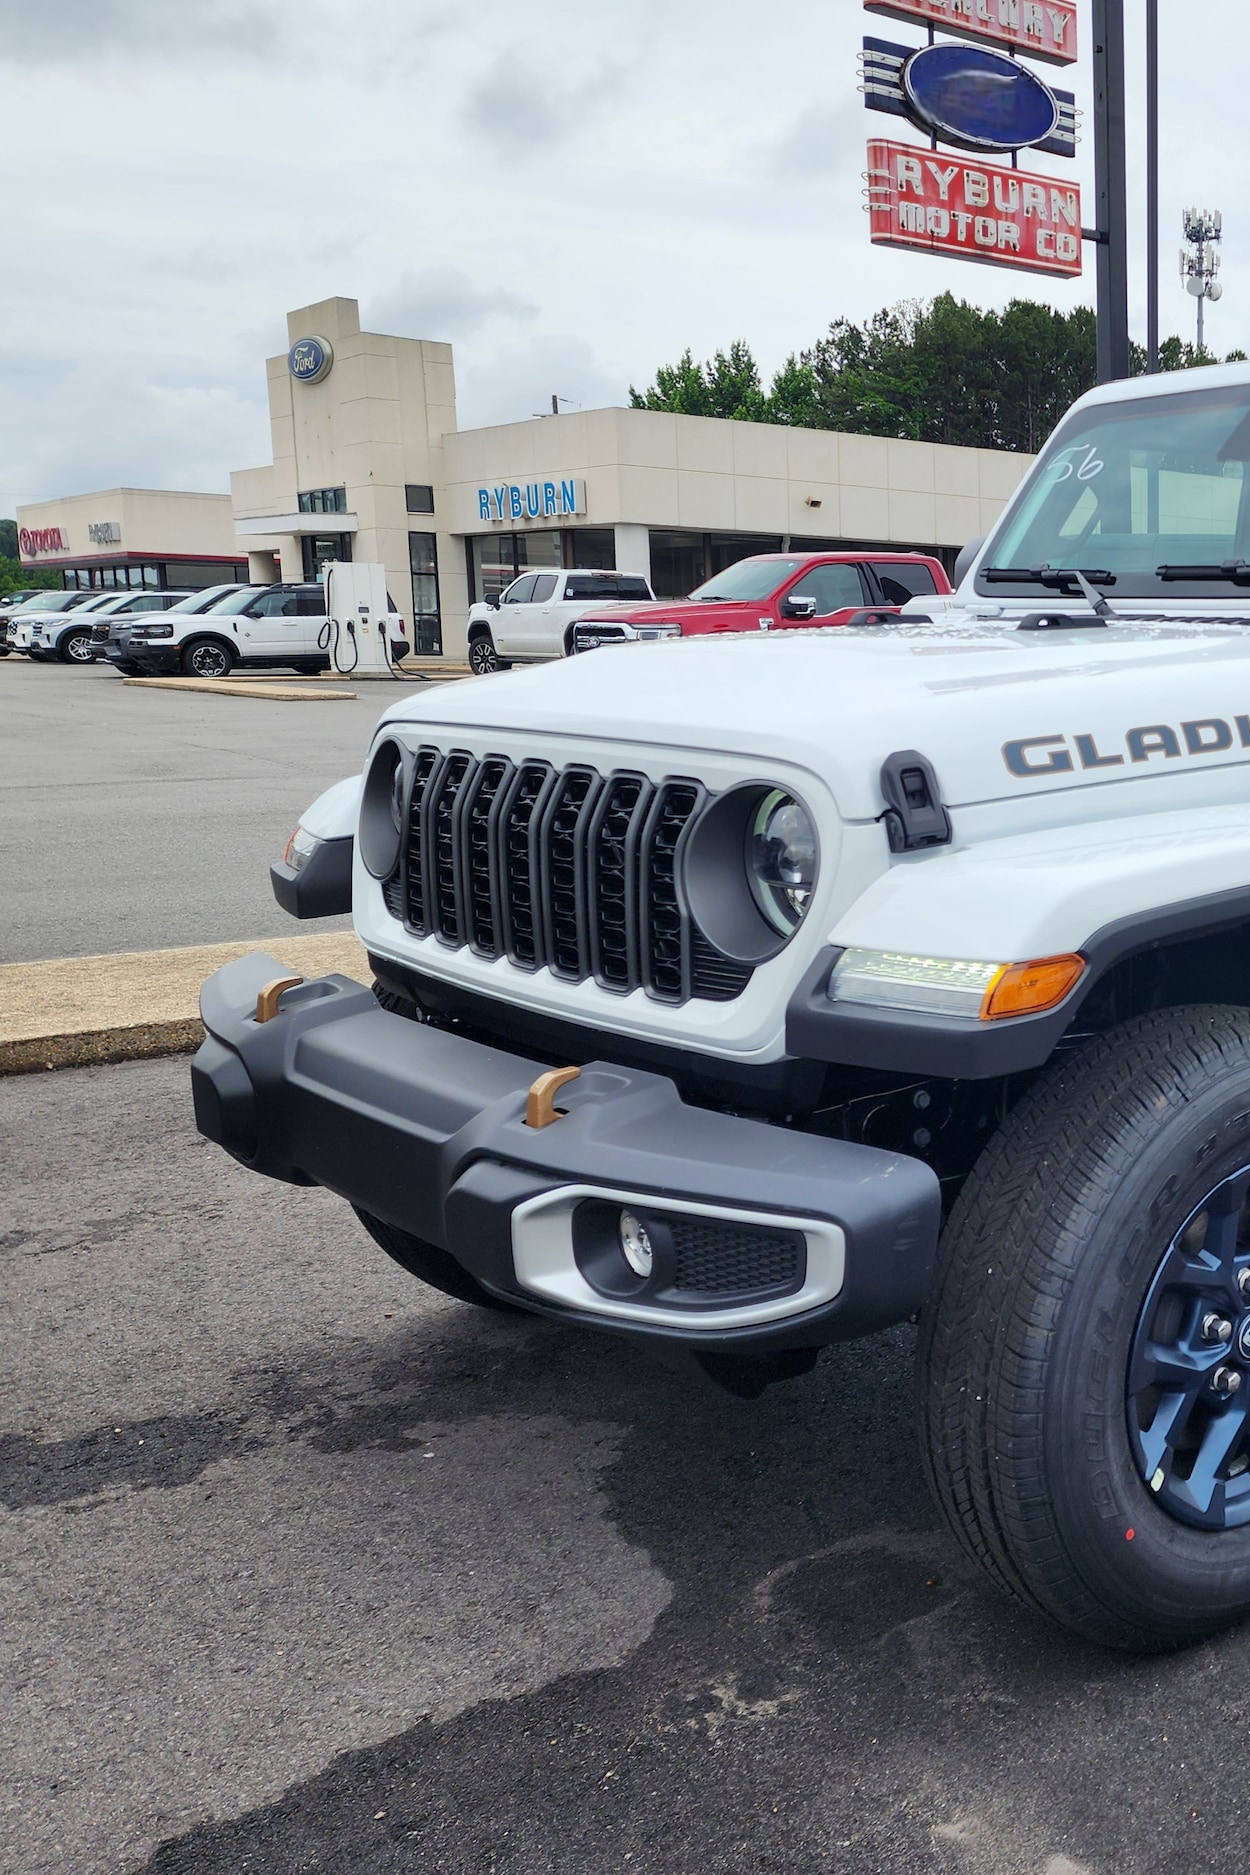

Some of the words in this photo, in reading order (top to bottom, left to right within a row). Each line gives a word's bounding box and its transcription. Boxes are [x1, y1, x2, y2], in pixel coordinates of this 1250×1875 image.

[896, 154, 1077, 226] RYBURN
[899, 200, 1020, 252] MOTOR
[1036, 228, 1078, 262] CO
[293, 346, 316, 372] Ford
[1046, 444, 1104, 484] 56
[478, 479, 576, 520] RYBURN
